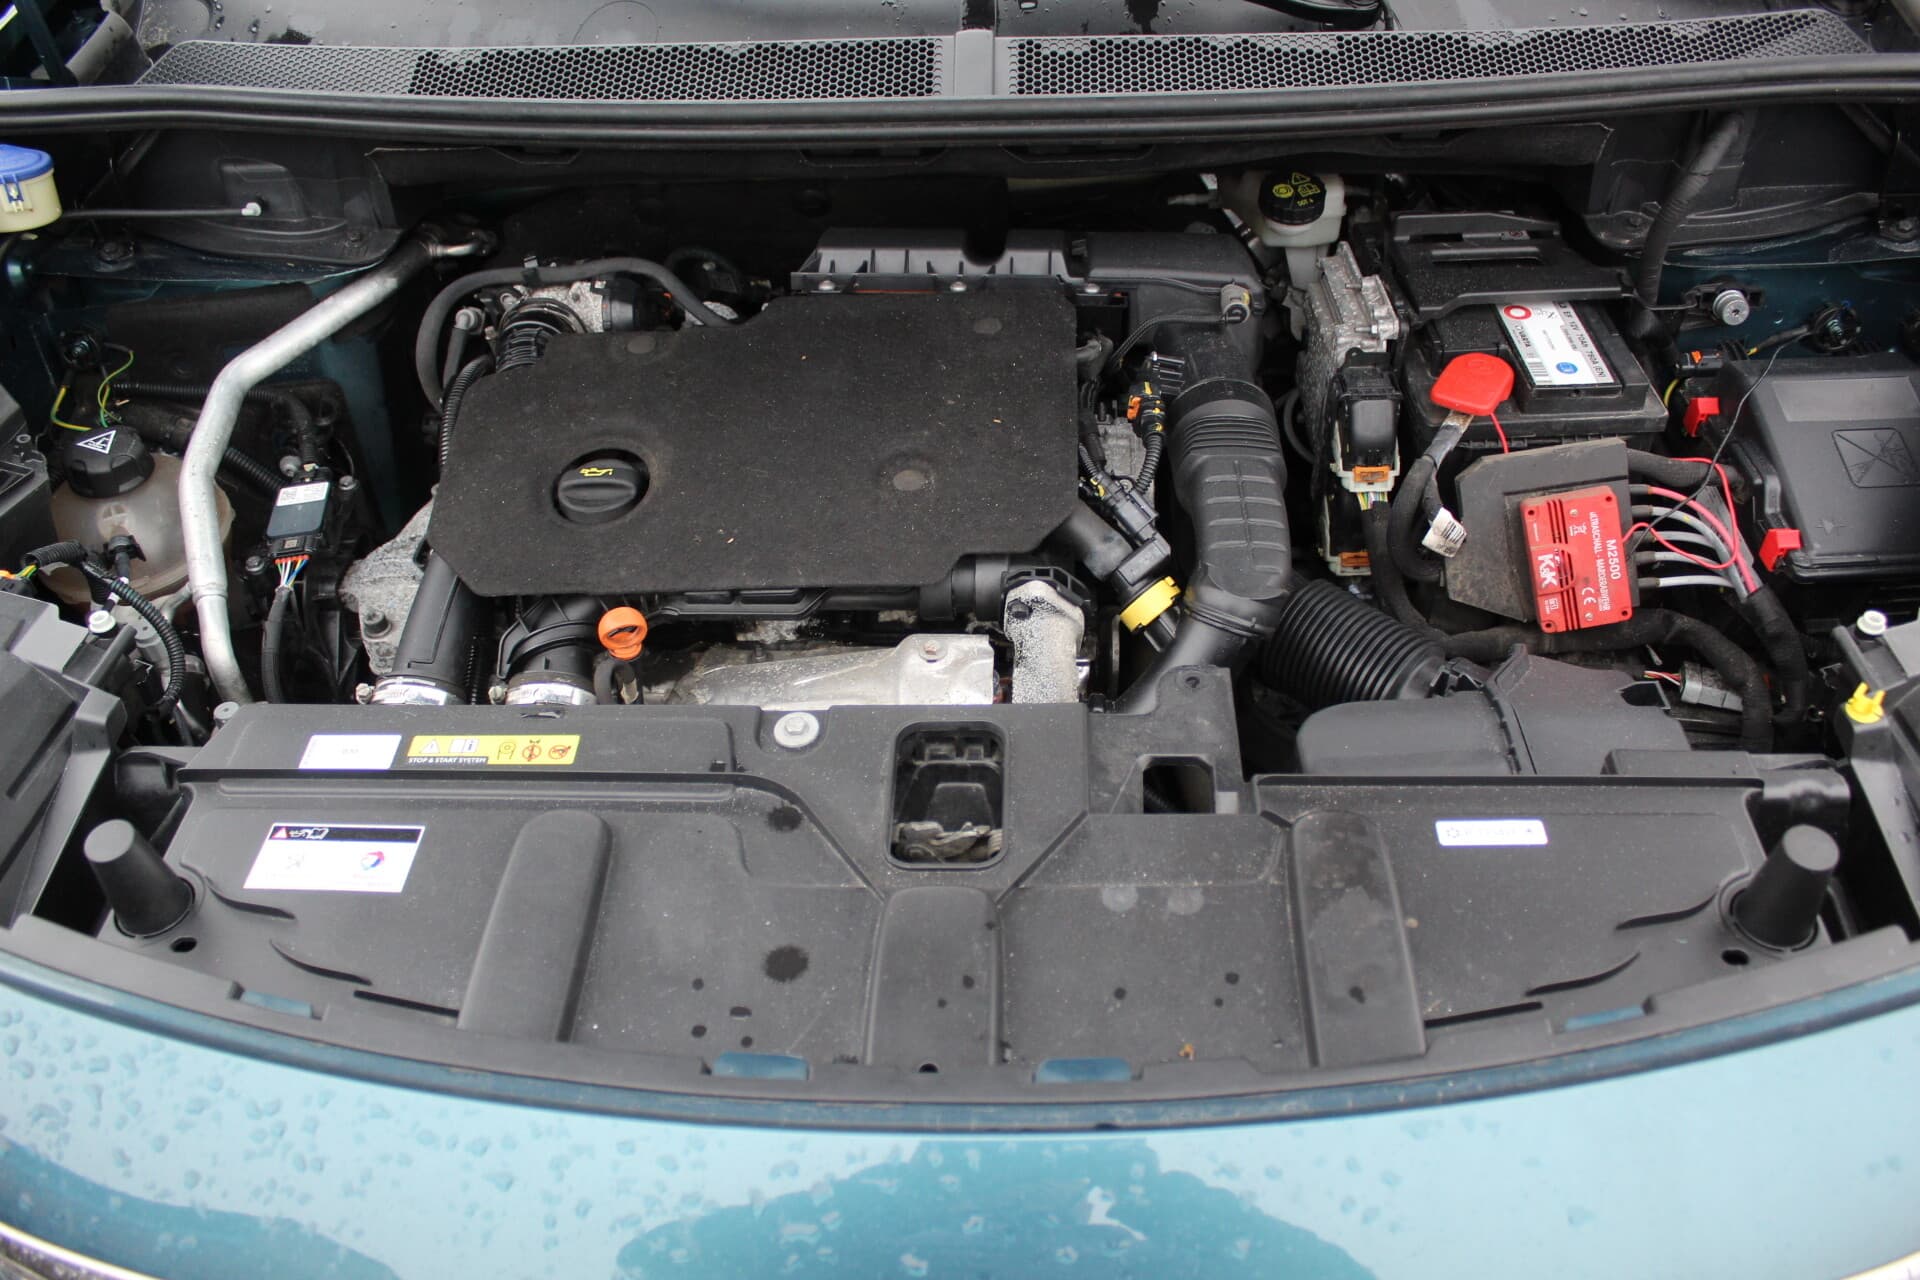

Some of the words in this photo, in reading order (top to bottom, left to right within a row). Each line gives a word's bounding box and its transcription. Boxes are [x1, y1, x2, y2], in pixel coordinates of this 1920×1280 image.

[1589, 511, 1603, 553] ULTRASCHALL
[1596, 559, 1611, 611] MARDERABWEHR
[1606, 539, 1621, 580] M2500
